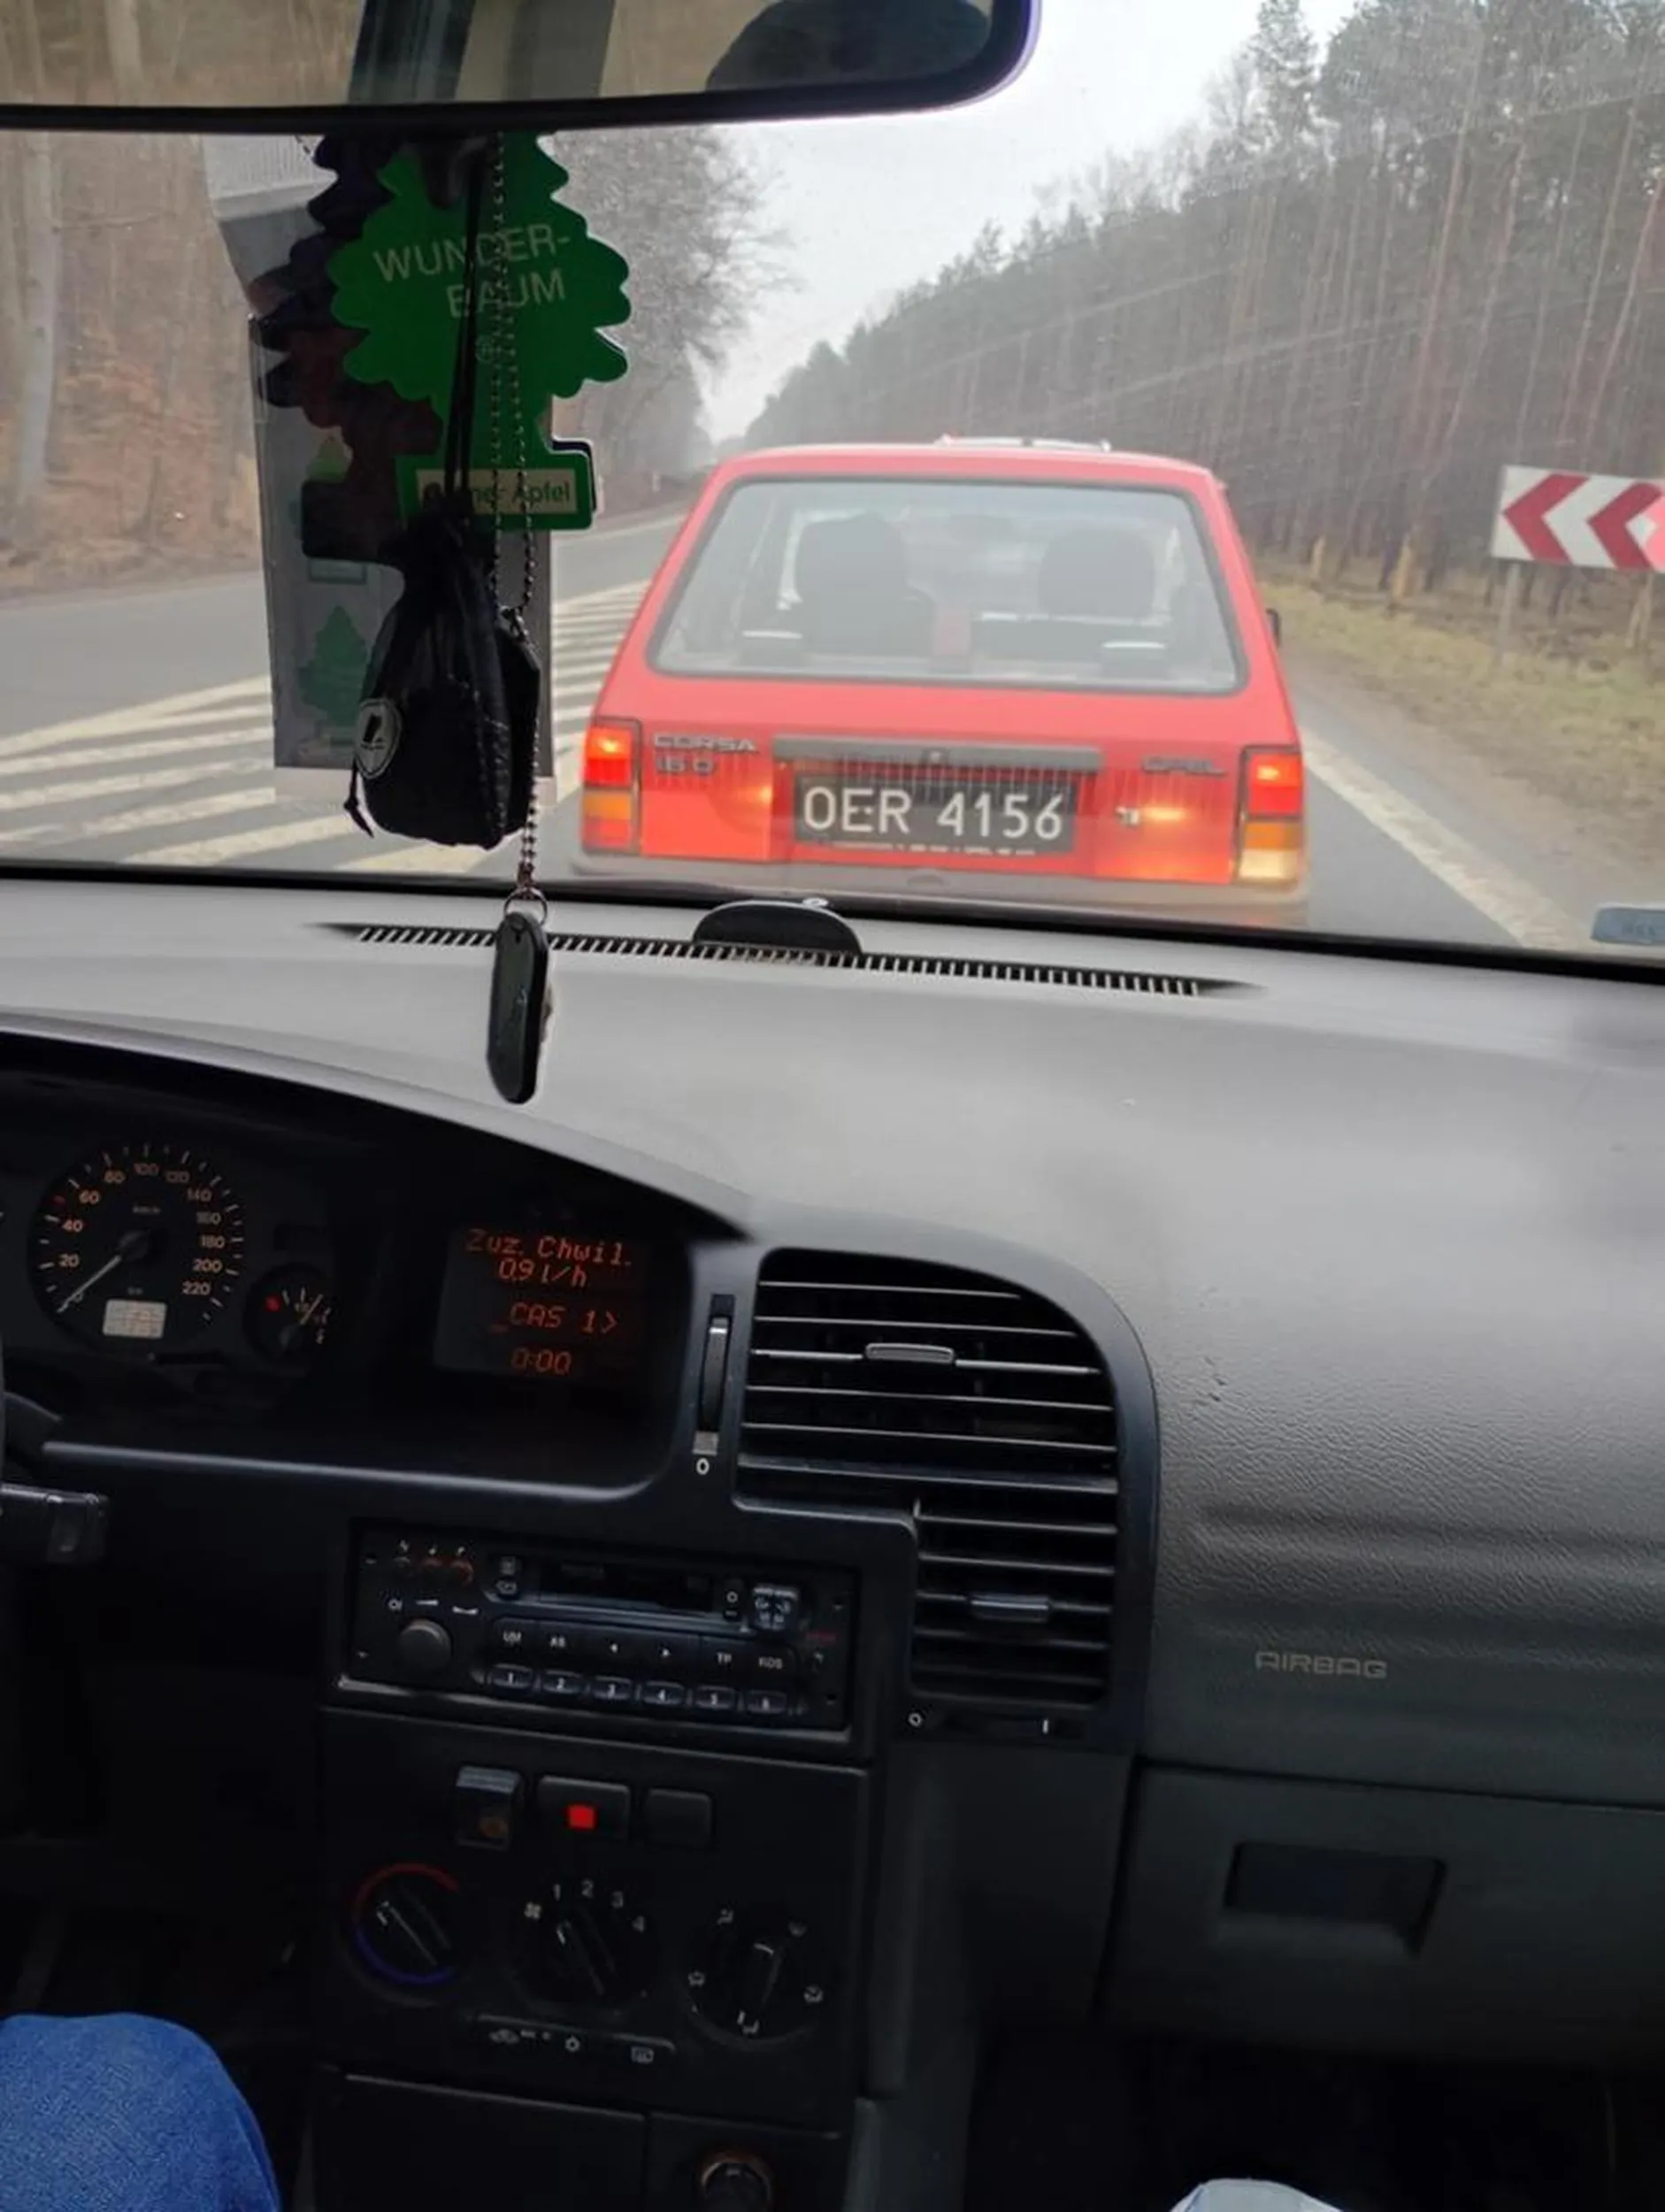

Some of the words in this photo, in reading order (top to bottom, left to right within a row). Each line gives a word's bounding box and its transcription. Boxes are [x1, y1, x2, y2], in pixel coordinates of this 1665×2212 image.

[803, 786, 913, 834] OER
[936, 791, 1063, 841] 4156
[1255, 1650, 1388, 1679] AIRBAG
